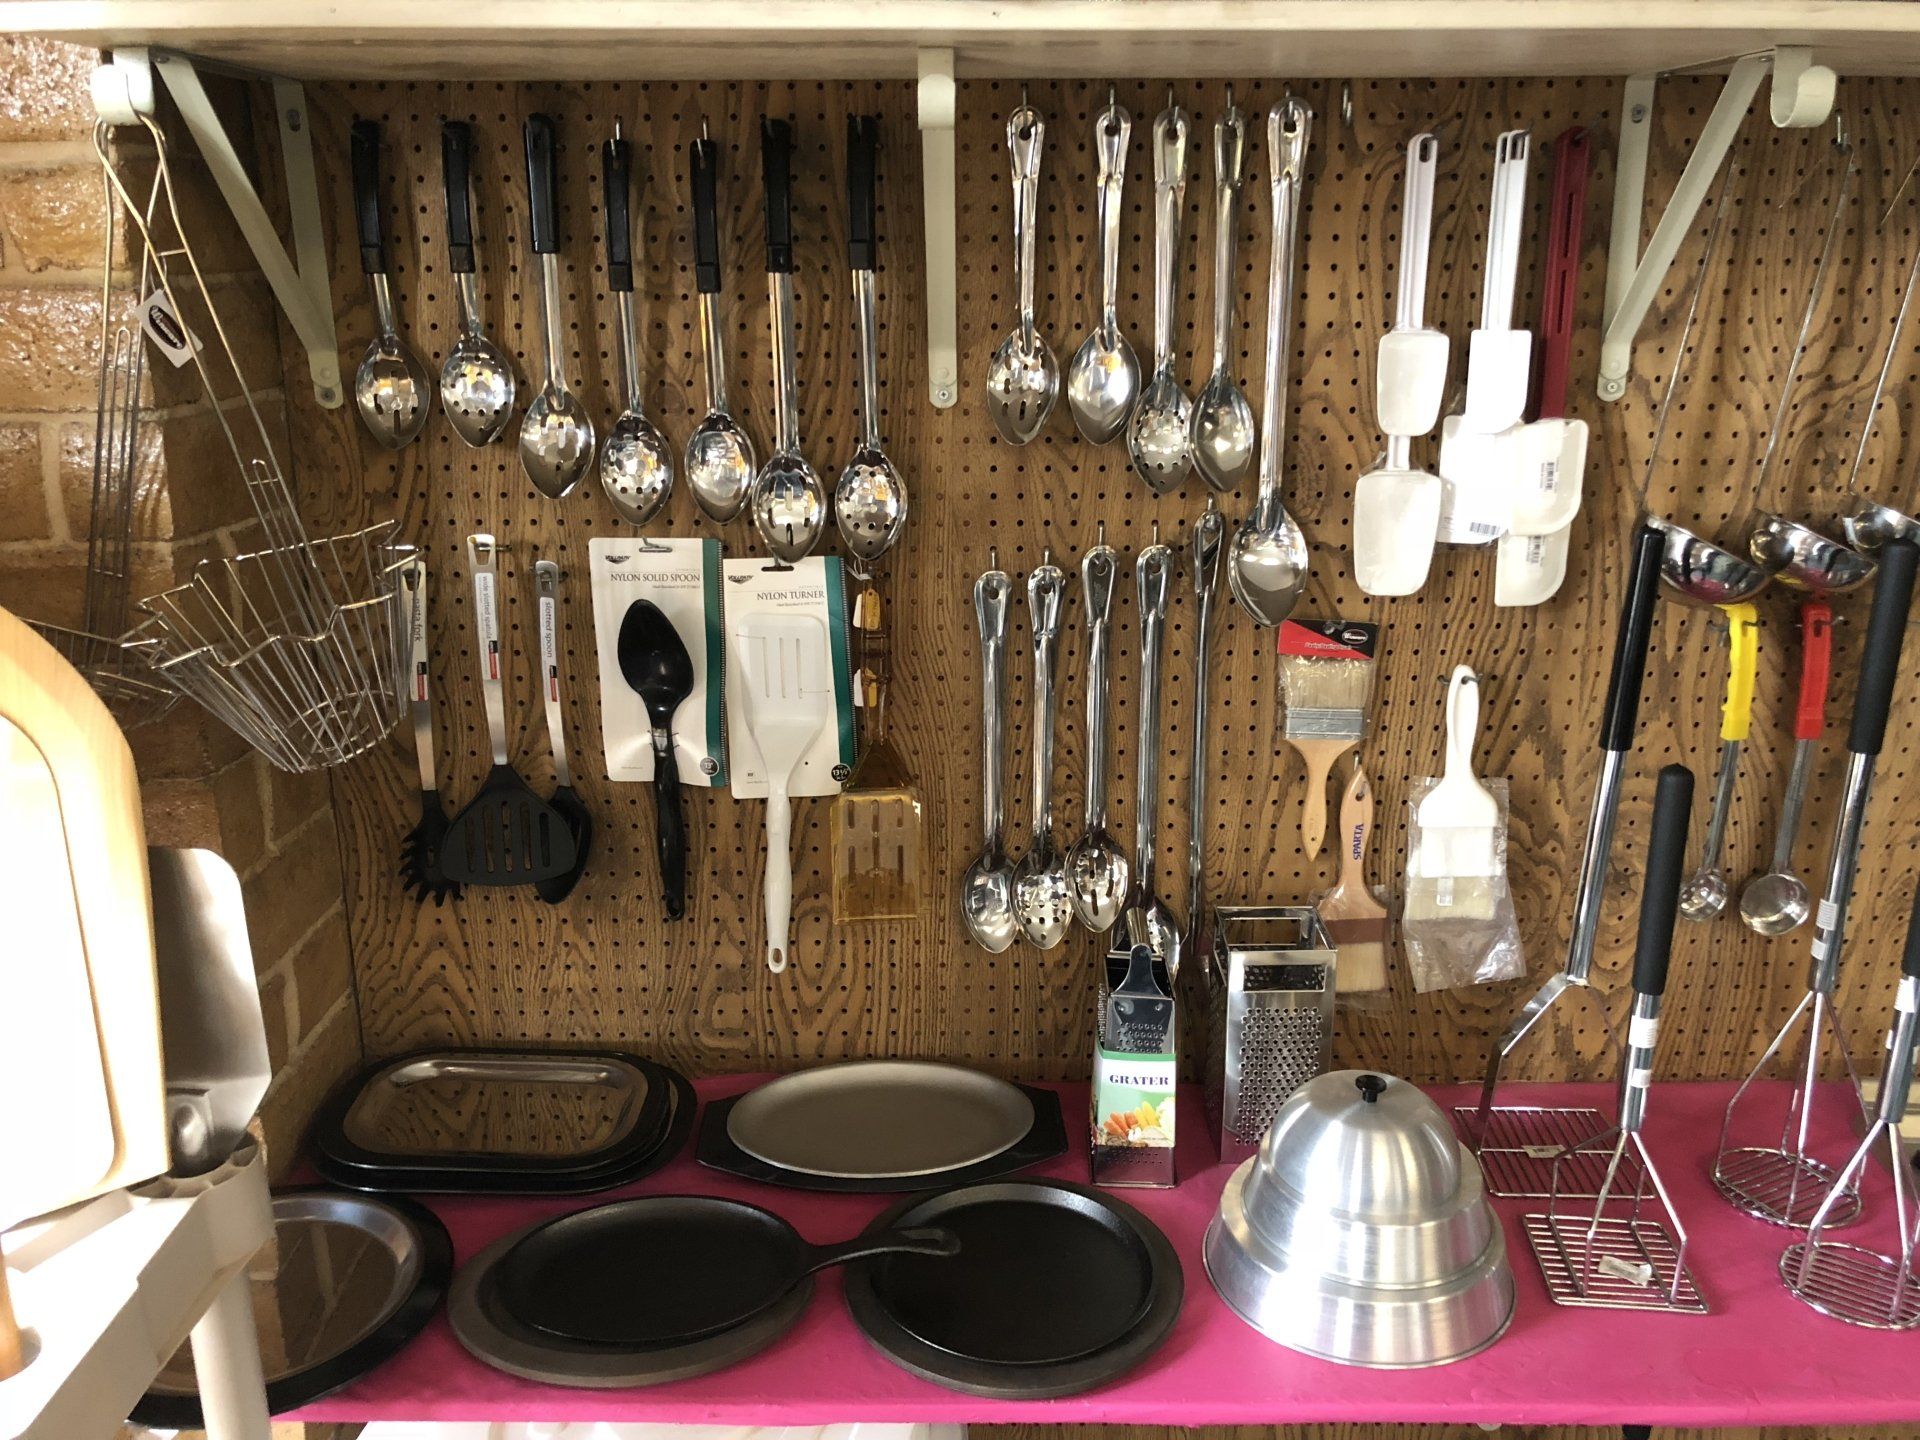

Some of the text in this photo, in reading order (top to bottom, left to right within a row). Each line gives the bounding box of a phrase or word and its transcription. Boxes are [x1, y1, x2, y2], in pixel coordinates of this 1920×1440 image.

[610, 573, 701, 582] NYLON SOLID SPOON
[483, 593, 491, 615] slotted
[757, 591, 825, 601] NYLON TURNER
[544, 601, 553, 631] slotted
[413, 623, 423, 642] fork
[484, 616, 493, 639] spatula
[544, 632, 553, 658] spoon
[1353, 823, 1364, 860] SPARTA
[1109, 1074, 1169, 1085] GRATER
